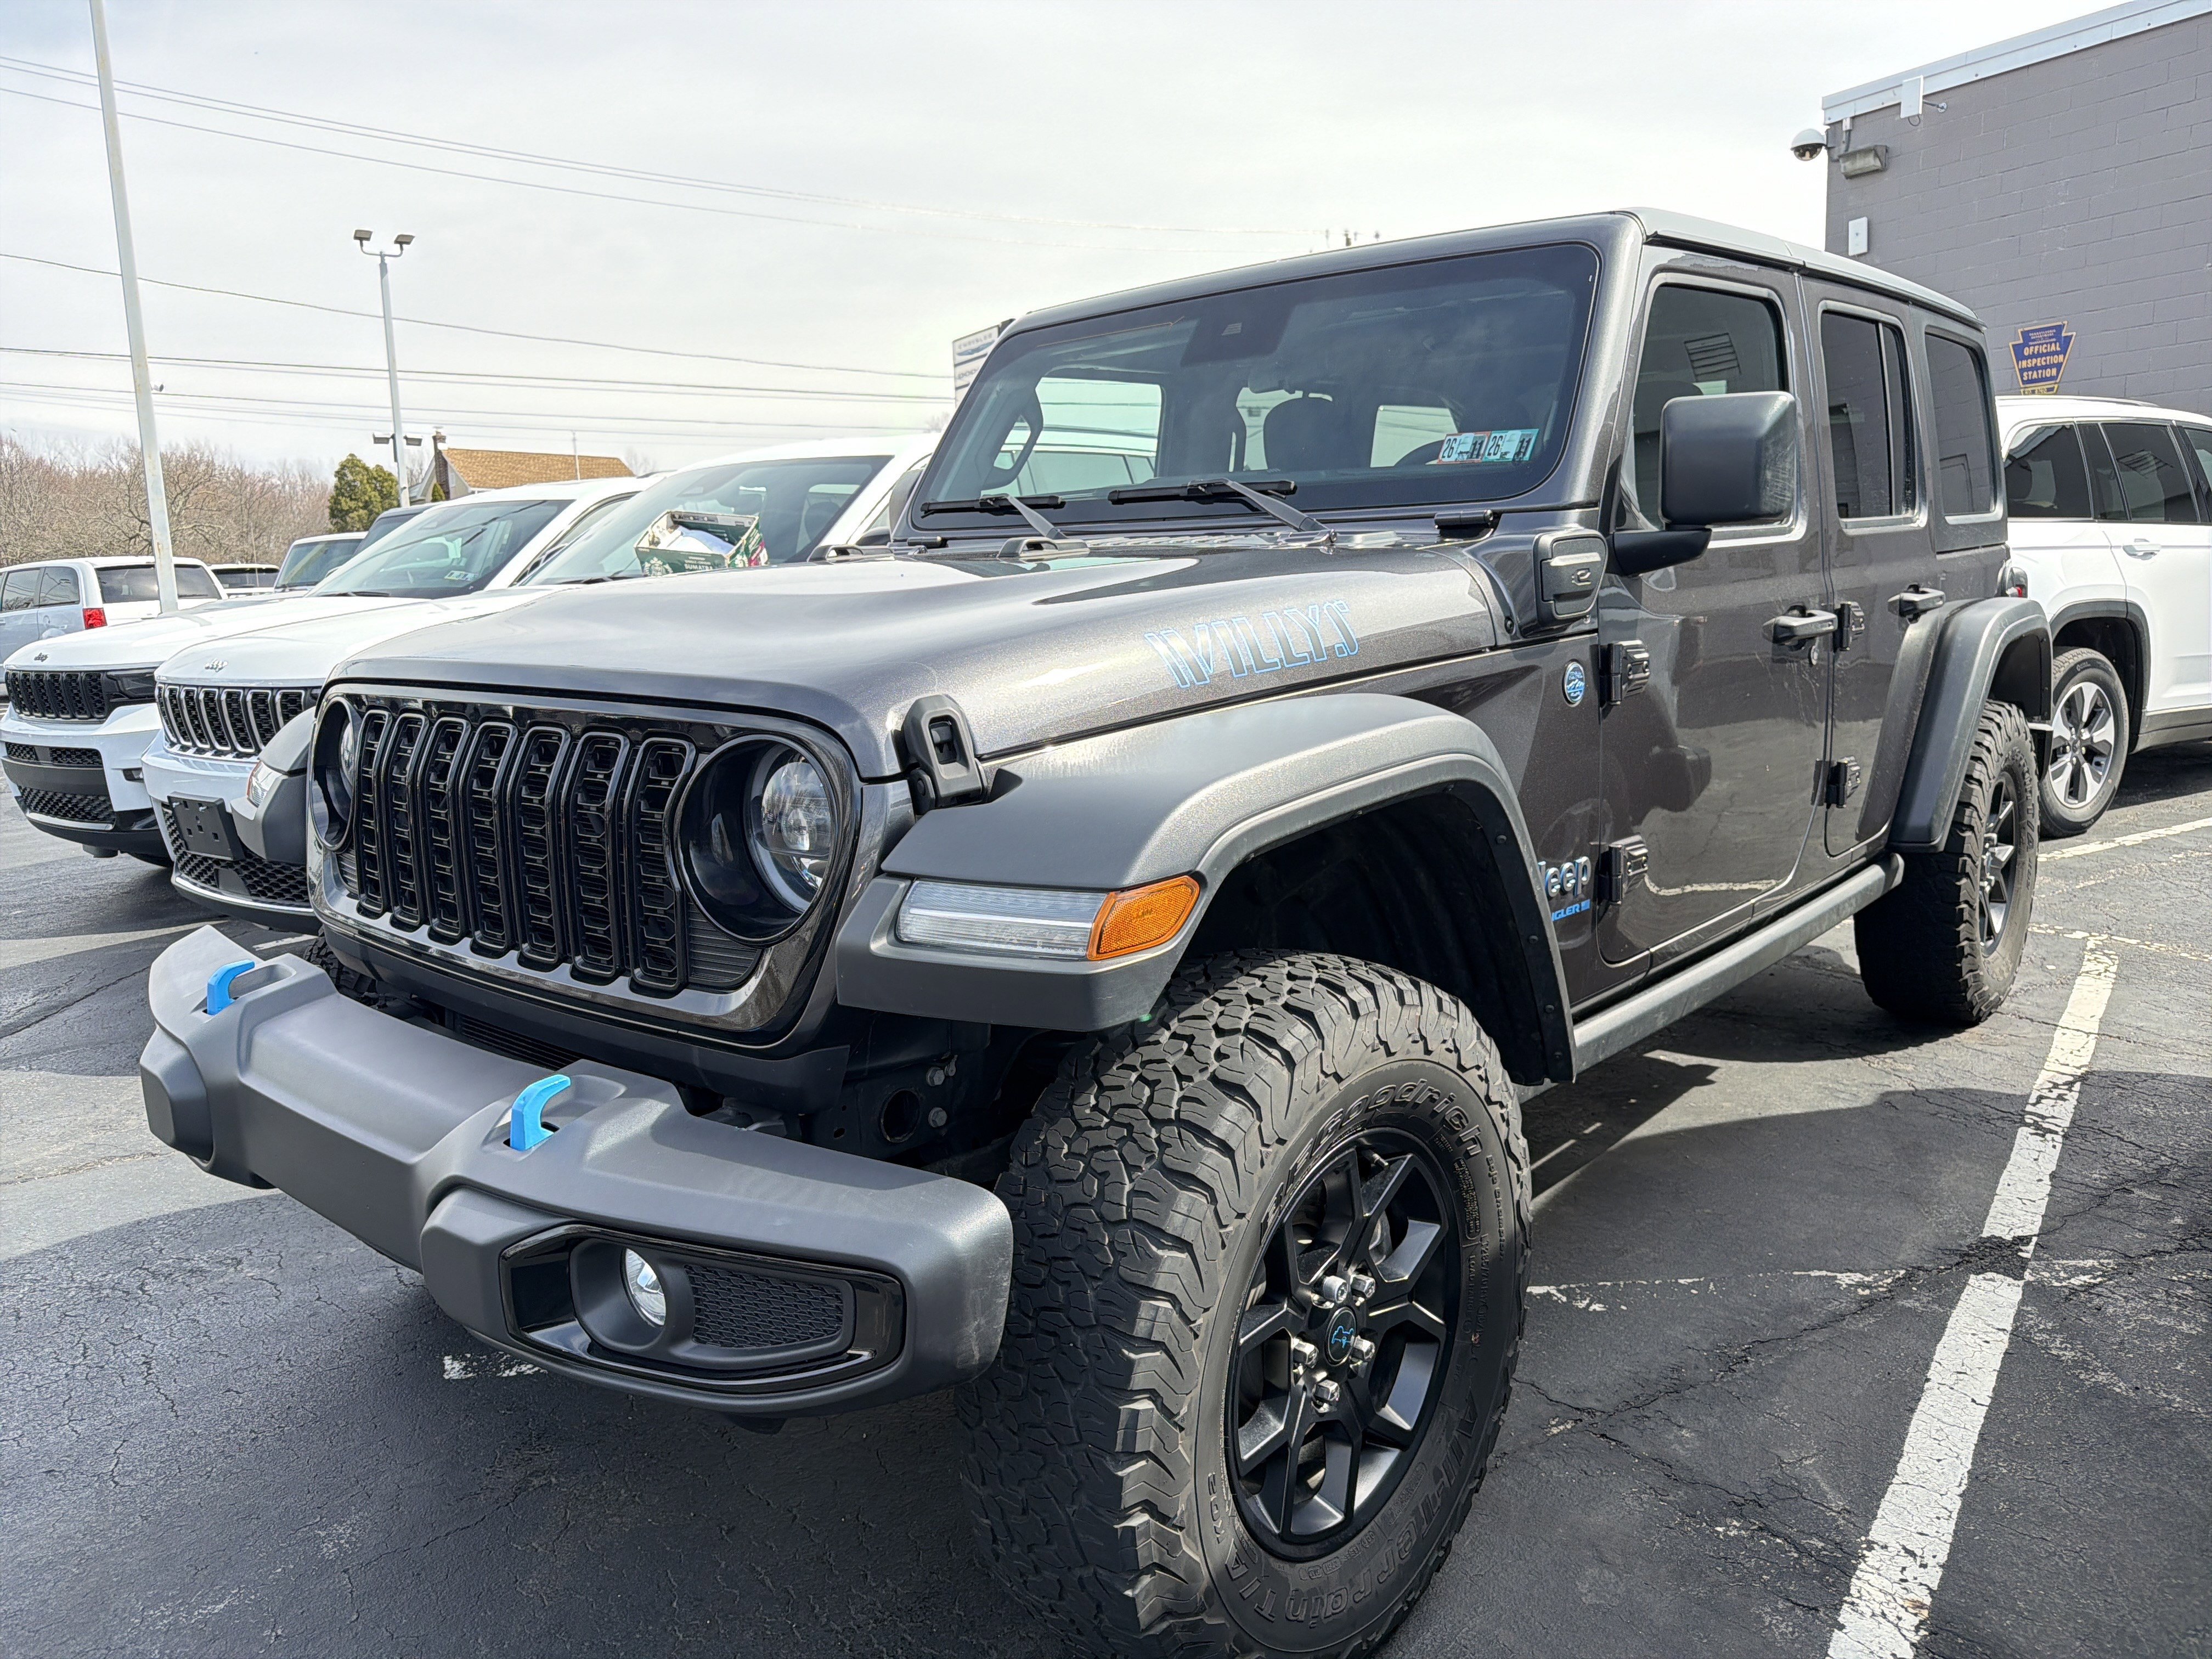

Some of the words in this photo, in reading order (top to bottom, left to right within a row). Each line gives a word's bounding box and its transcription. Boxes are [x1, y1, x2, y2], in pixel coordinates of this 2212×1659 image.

[2023, 342, 2061, 356] OFFICIAL
[2018, 354, 2064, 369] INSPECTION
[2023, 368, 2057, 381] STATION
[1441, 437, 1458, 459] 26
[1487, 435, 1503, 456] 26
[1144, 600, 1359, 689] WILLYS
[1551, 903, 1581, 922] GLER
[1207, 1471, 1225, 1545] KO2
[1285, 1386, 1479, 1628] All-Terrain
[1225, 1537, 1277, 1622] T/A
